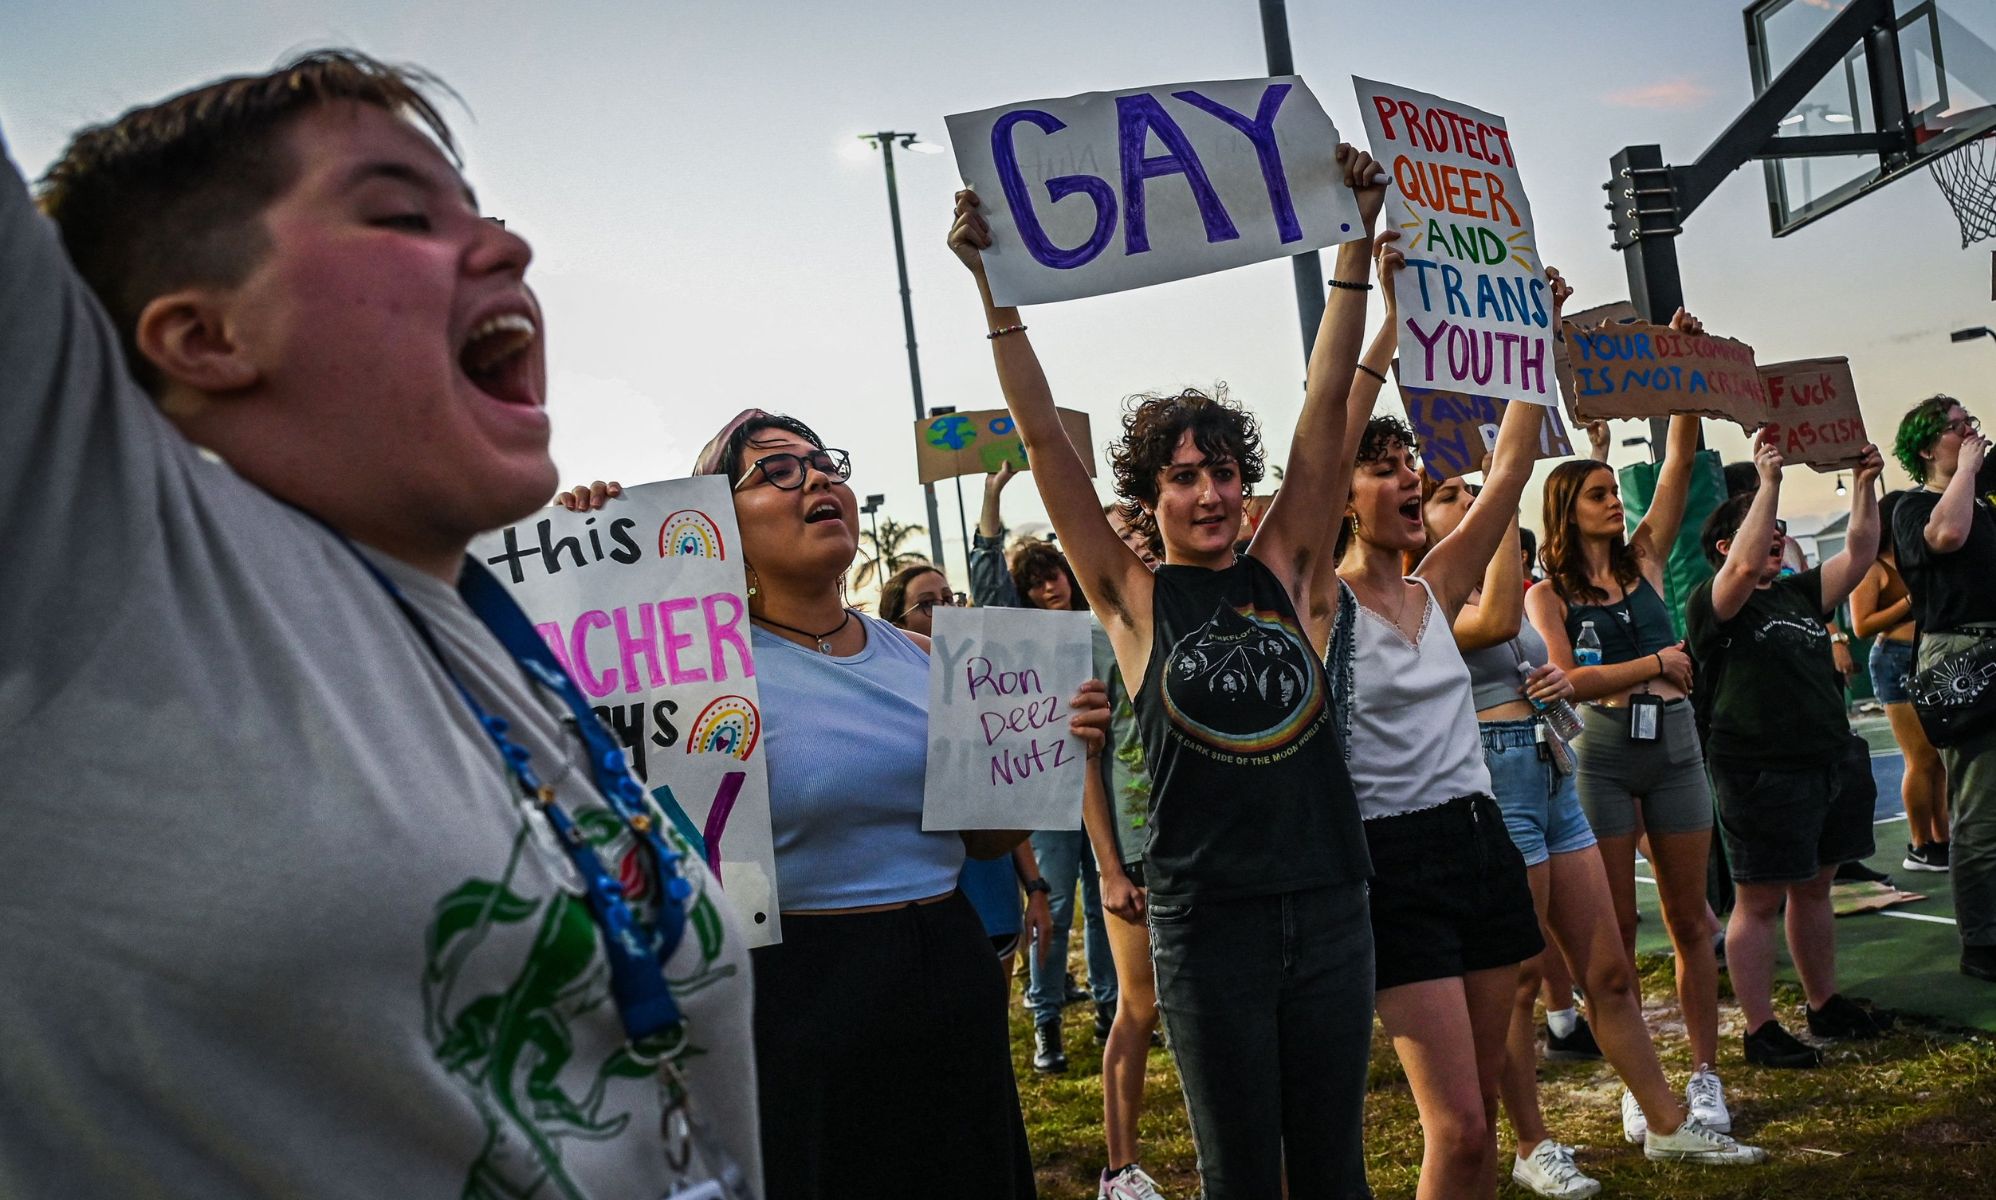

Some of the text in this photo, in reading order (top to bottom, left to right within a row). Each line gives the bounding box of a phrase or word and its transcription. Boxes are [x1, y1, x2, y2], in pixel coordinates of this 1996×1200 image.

[1372, 96, 1514, 168] PROTECT
[1393, 155, 1520, 227] QUEER
[1427, 219, 1507, 265] AND
[1404, 259, 1548, 328] TRANS
[1406, 318, 1546, 394] YOUTH
[1573, 332, 1656, 362] YOUR
[1578, 366, 1614, 395] IS
[1622, 366, 1682, 393] NOT
[1690, 368, 1709, 394] A
[488, 517, 641, 583] this
[967, 657, 1042, 700] Ron
[980, 697, 1067, 746] Deez
[992, 739, 1075, 786] Nutz
[1184, 739, 1210, 757] DARK
[1211, 751, 1234, 763] SIDE
[1236, 755, 1248, 766] OF
[1250, 755, 1271, 766] THE
[1272, 743, 1299, 762] MOON
